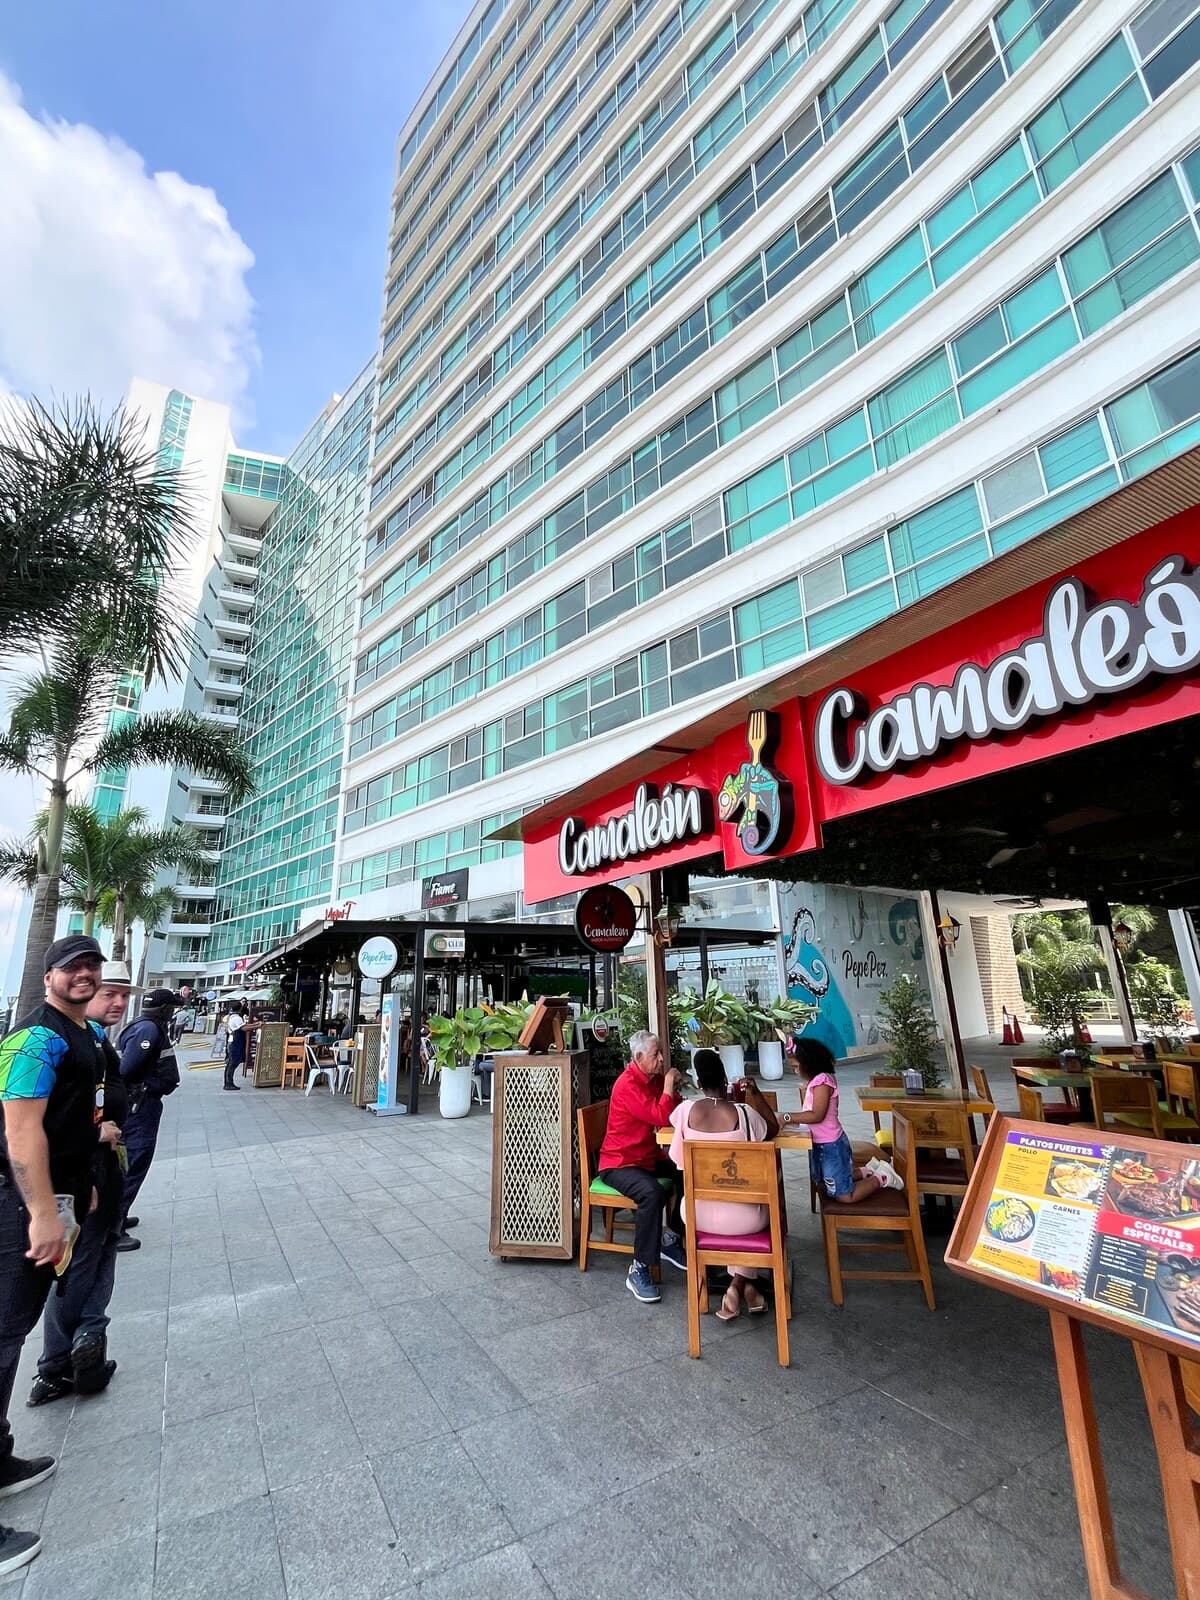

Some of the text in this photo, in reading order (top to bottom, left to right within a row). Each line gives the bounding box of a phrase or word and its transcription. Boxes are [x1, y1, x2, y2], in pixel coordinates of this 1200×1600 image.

[560, 783, 700, 875] Camaleón
[1018, 1147, 1038, 1155] POLLO
[1020, 1137, 1094, 1156] PLATOS FUERTES
[1052, 1204, 1081, 1216] CARNES
[1134, 1220, 1182, 1240] CORTES
[1123, 1227, 1195, 1253] ESPECIALES
